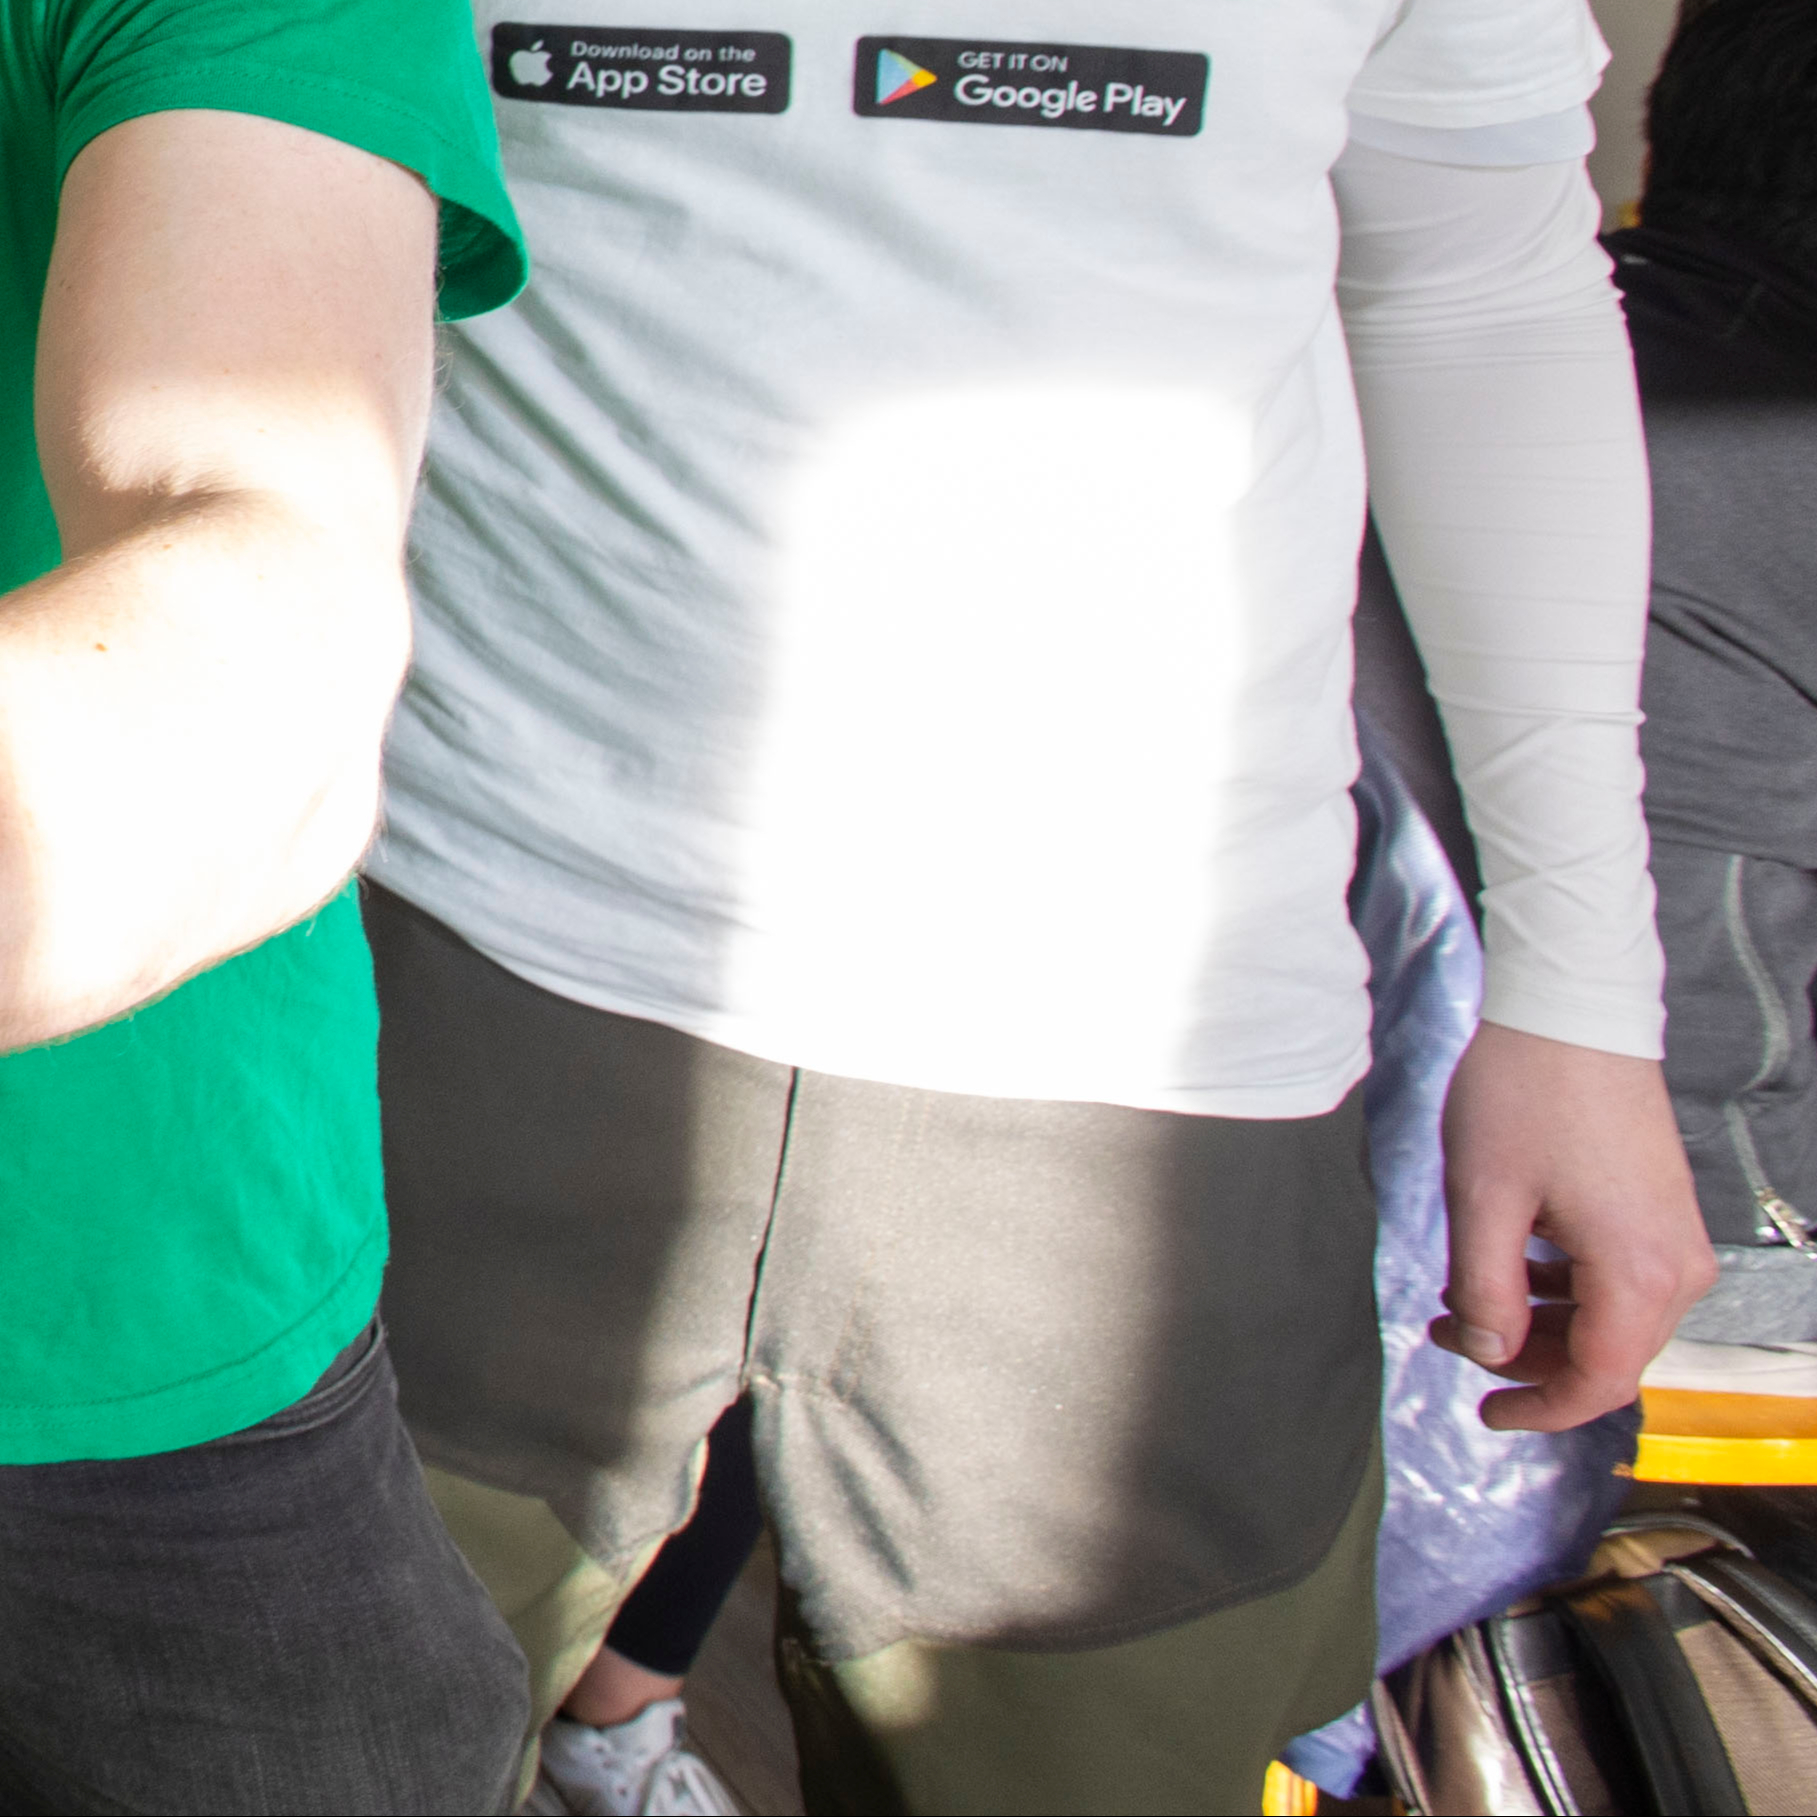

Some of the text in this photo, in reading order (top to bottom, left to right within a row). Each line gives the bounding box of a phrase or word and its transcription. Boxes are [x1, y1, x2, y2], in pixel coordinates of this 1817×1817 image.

[570, 40, 757, 63] Download on the
[957, 51, 1069, 73] GET IT ON
[566, 60, 768, 99] App Store
[953, 73, 1187, 127] Google Play
